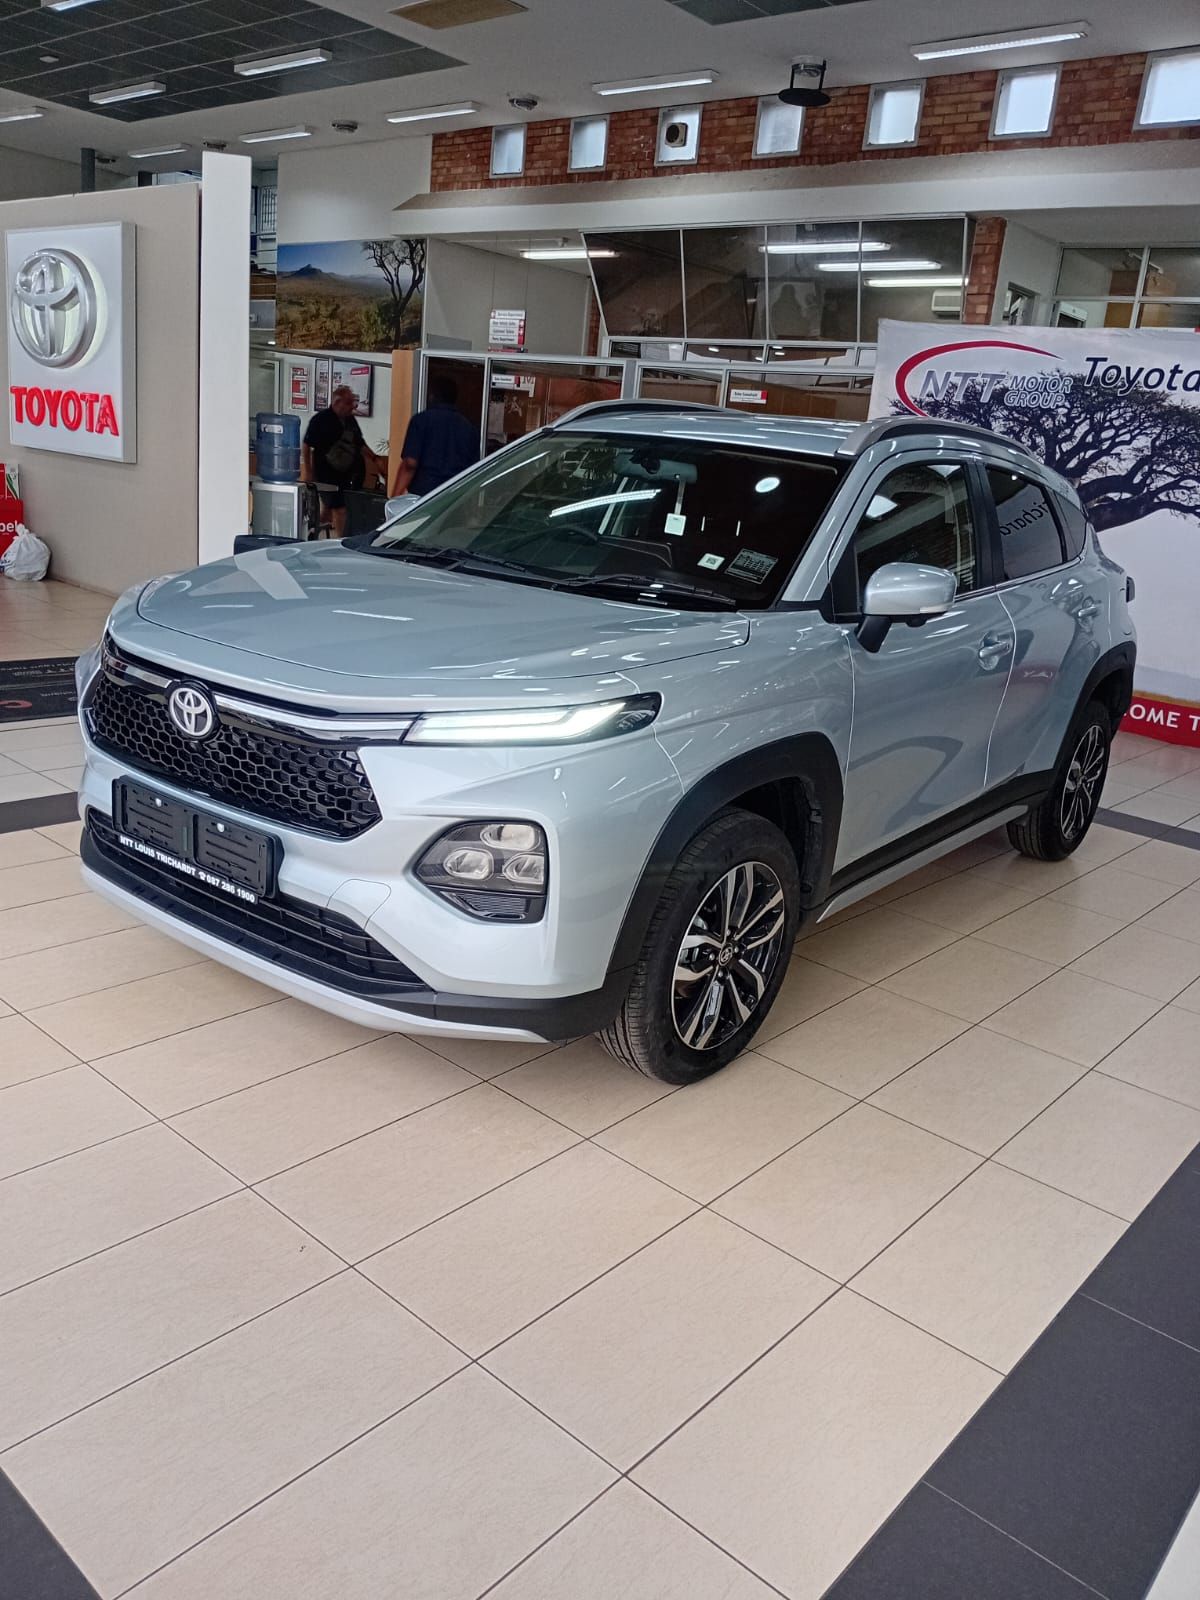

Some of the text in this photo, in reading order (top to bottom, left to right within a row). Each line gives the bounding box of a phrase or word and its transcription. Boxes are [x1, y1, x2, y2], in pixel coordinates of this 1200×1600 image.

[919, 370, 1006, 403] NTT
[1009, 375, 1073, 393] MOTOR
[1084, 356, 1200, 396] Toyota
[10, 386, 119, 436] TOYOTA
[1004, 390, 1066, 409] GROUP
[1123, 704, 1181, 728] OME
[120, 835, 134, 848] NTT
[134, 841, 155, 858] LOUIS
[156, 851, 196, 876] TRICHARDT
[206, 874, 220, 887] 087
[237, 888, 255, 903] 1900
